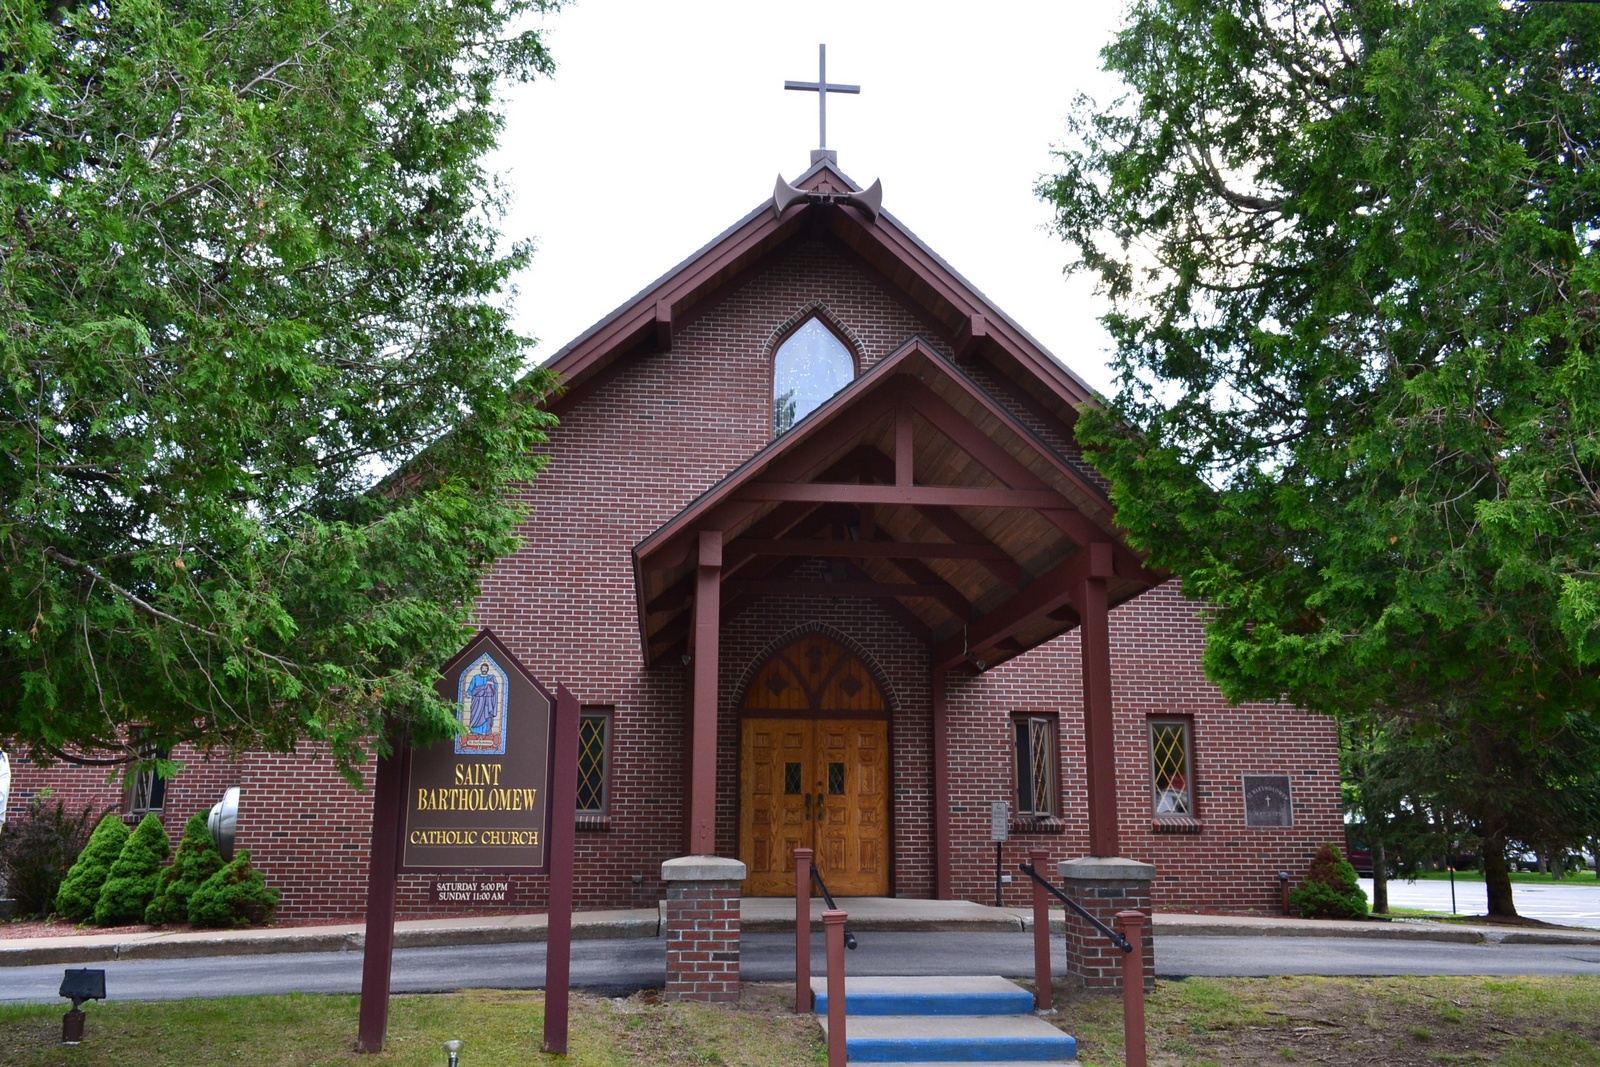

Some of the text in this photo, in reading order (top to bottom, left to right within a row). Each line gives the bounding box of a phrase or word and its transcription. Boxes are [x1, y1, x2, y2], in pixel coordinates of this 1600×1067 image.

[455, 763, 501, 786] SAINT
[417, 788, 537, 811] BARTHOLOMEW
[410, 830, 539, 845] CATHOLIC CHURCH
[436, 882, 508, 891] SATURDAY 5:00 PM
[438, 892, 505, 901] SUNDAY 11:00 AM
